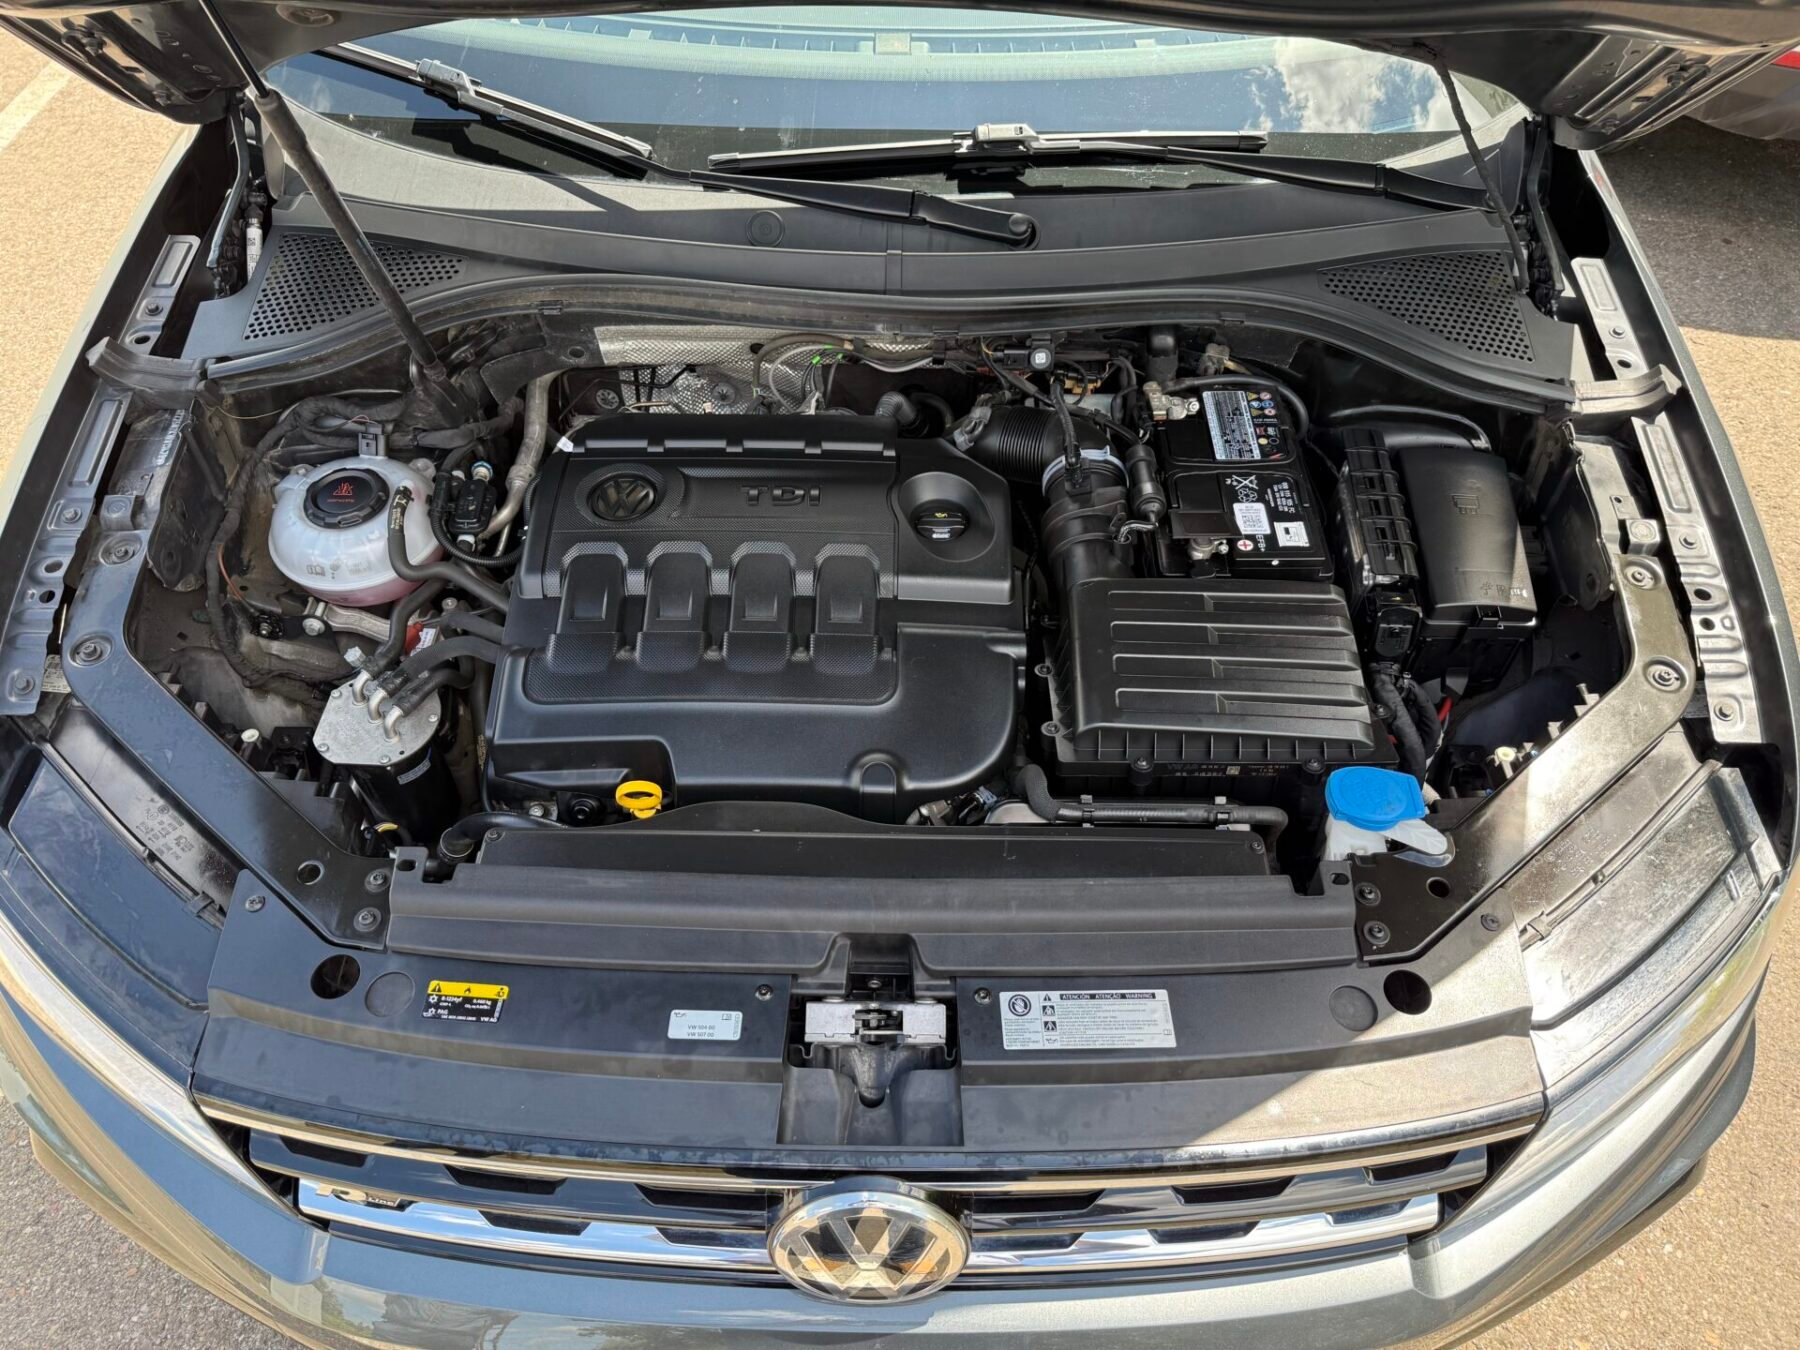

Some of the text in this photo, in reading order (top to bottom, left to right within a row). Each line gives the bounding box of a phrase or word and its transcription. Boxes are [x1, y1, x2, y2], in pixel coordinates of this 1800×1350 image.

[741, 486, 820, 506] TDI
[1095, 992, 1121, 1001] ATENÇÃO
[770, 1193, 969, 1305] VW
